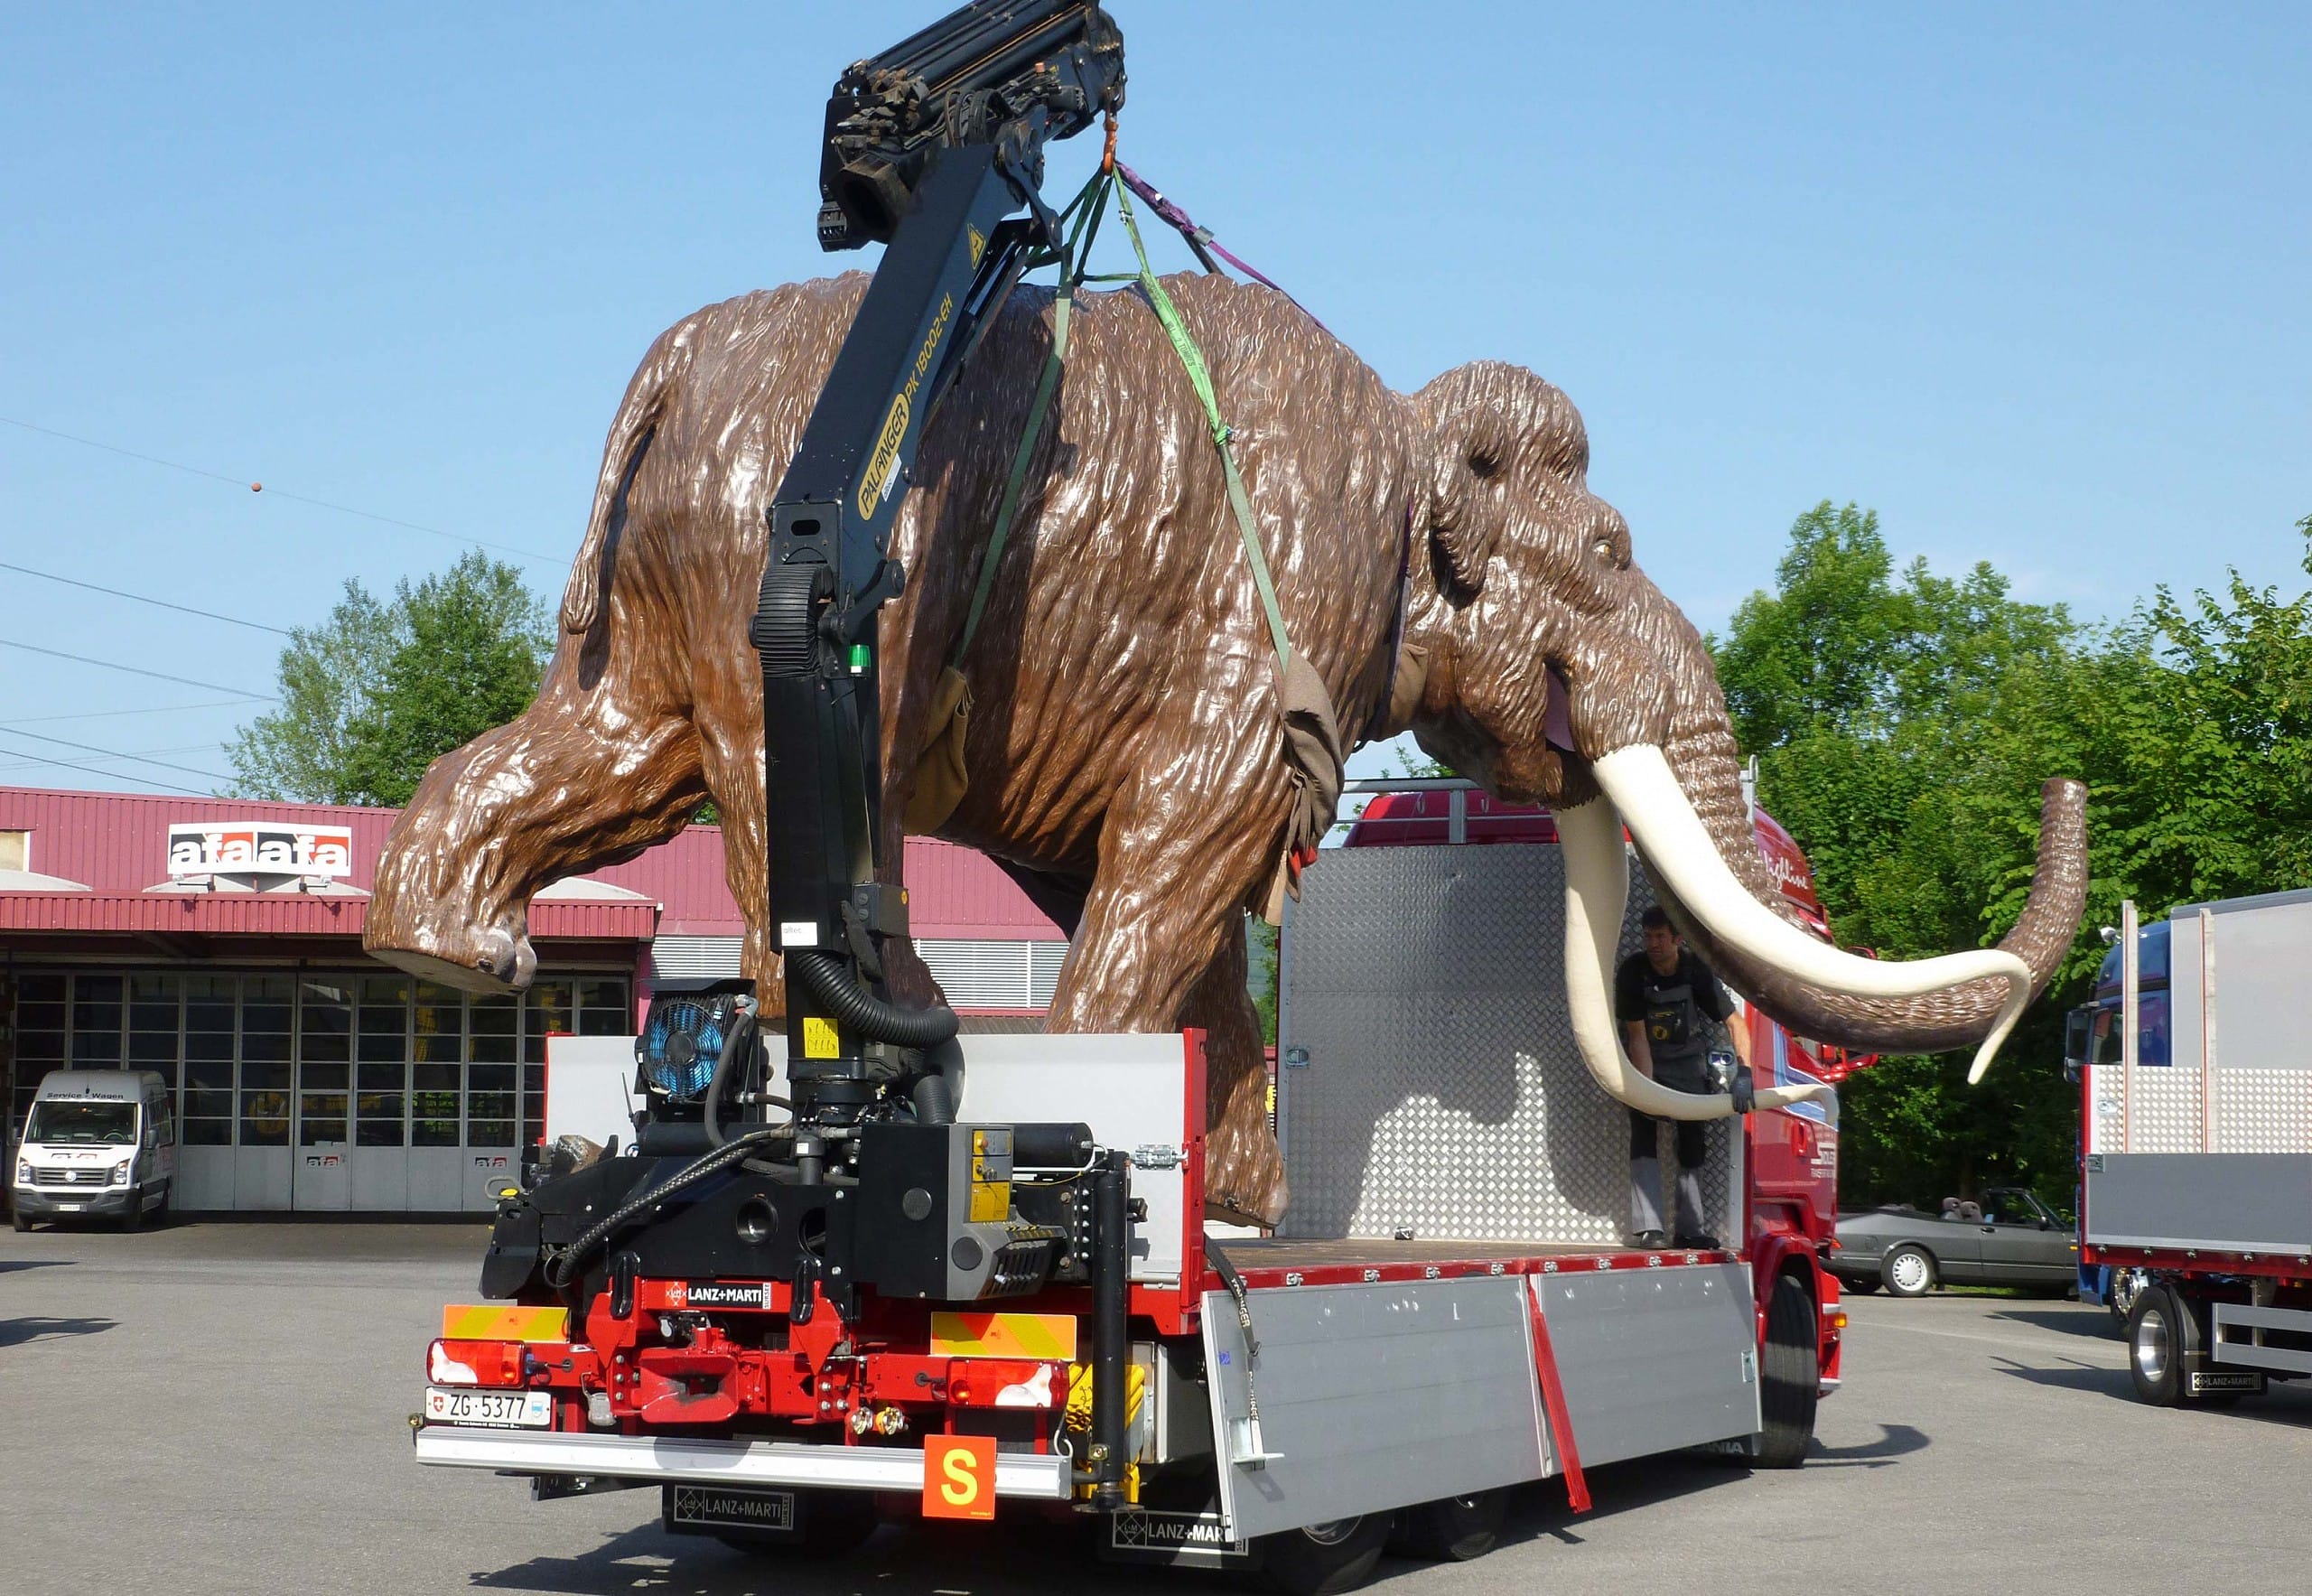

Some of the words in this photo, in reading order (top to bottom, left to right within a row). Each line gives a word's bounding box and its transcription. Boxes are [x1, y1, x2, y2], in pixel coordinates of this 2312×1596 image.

[905, 373, 919, 405] PK
[861, 401, 907, 513] PALFINGER
[687, 1287, 762, 1302] LANZ+MARTI
[940, 1448, 978, 1507] S
[704, 1498, 781, 1518] LANZ+MARTI
